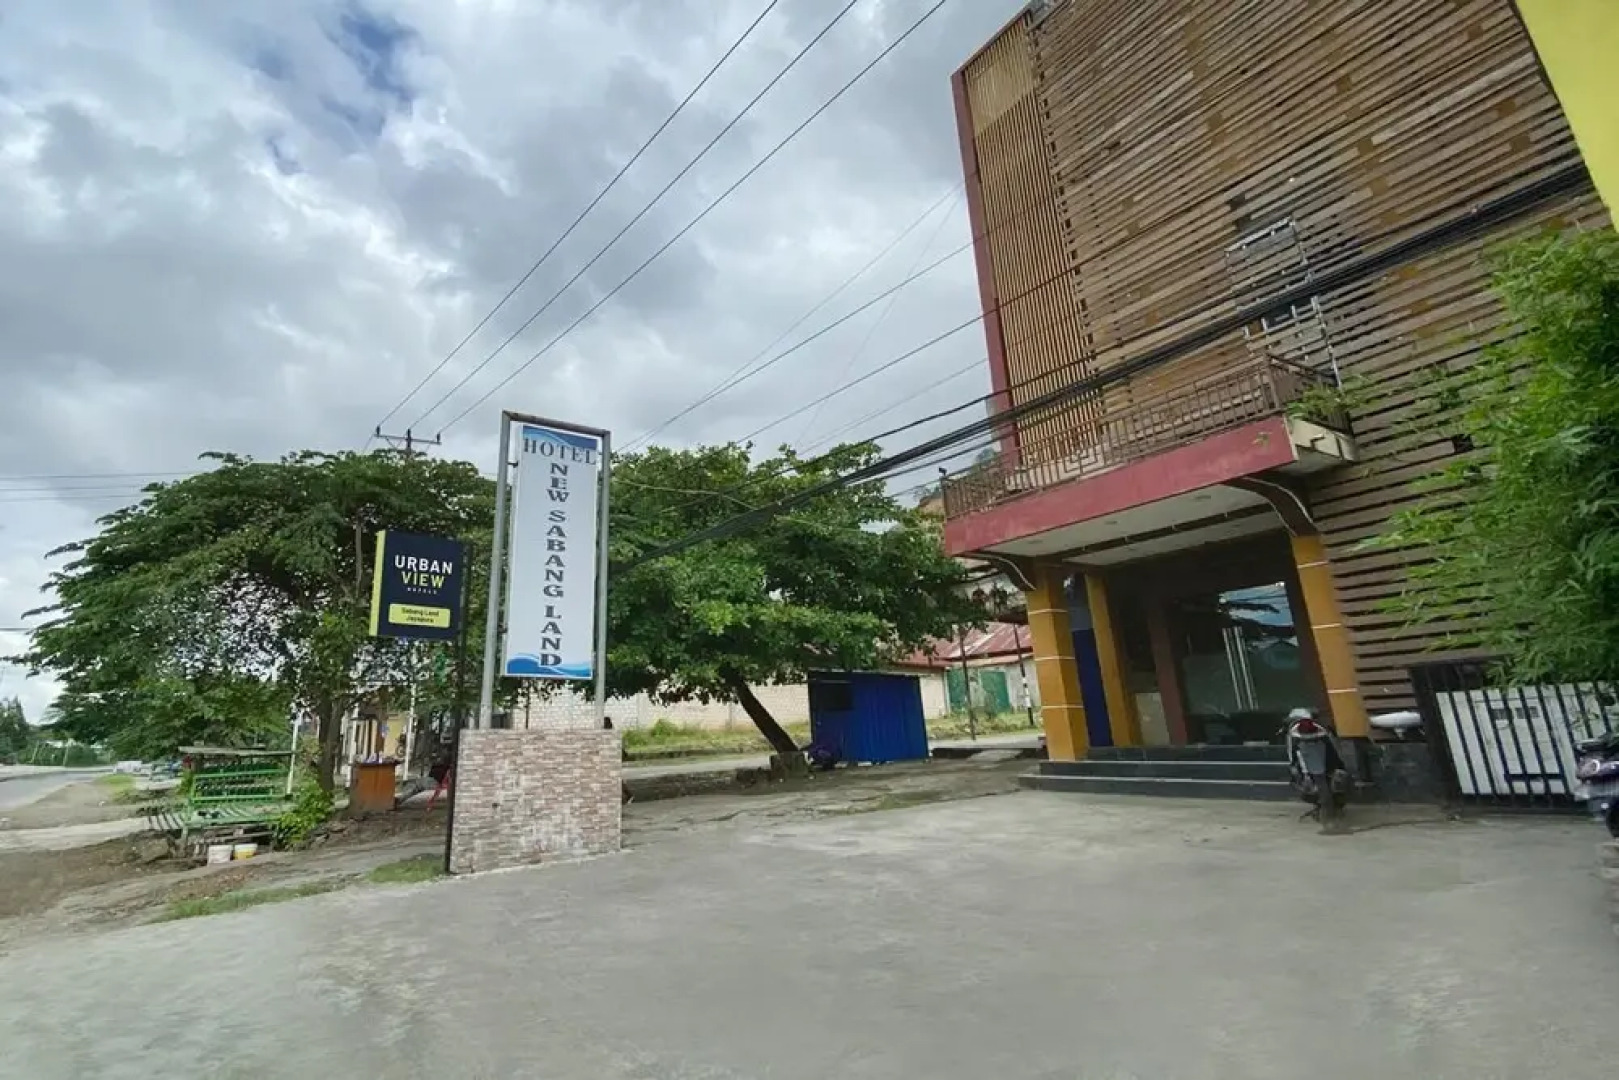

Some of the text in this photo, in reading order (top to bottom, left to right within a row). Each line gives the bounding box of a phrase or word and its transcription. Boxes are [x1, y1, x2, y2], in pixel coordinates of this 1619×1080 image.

[523, 438, 597, 466] HOTEL
[394, 554, 454, 576] URBAN
[540, 462, 570, 667] NEW SABANG LAND
[401, 571, 446, 589] VIEW
